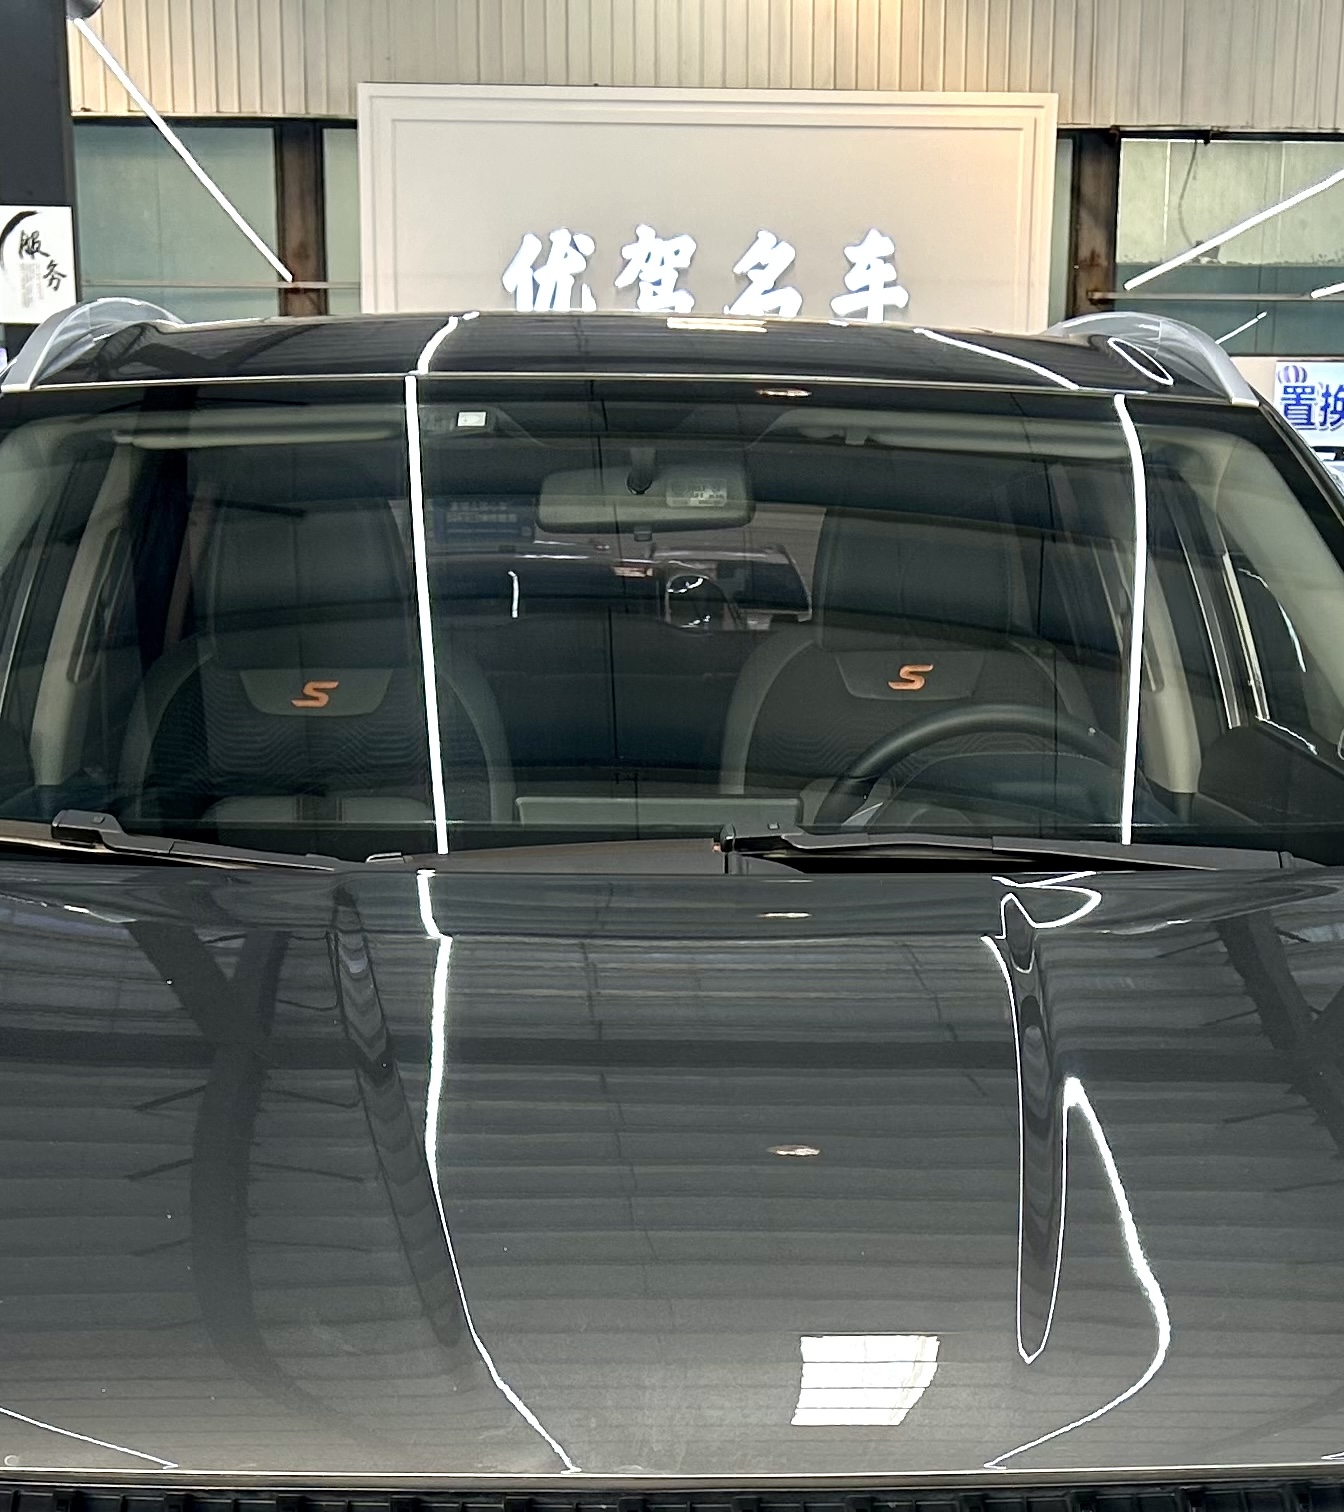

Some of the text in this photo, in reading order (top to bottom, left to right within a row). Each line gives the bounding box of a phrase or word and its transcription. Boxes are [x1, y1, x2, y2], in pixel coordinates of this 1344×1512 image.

[18, 229, 67, 291] 服务
[502, 224, 910, 323] 优驾名车
